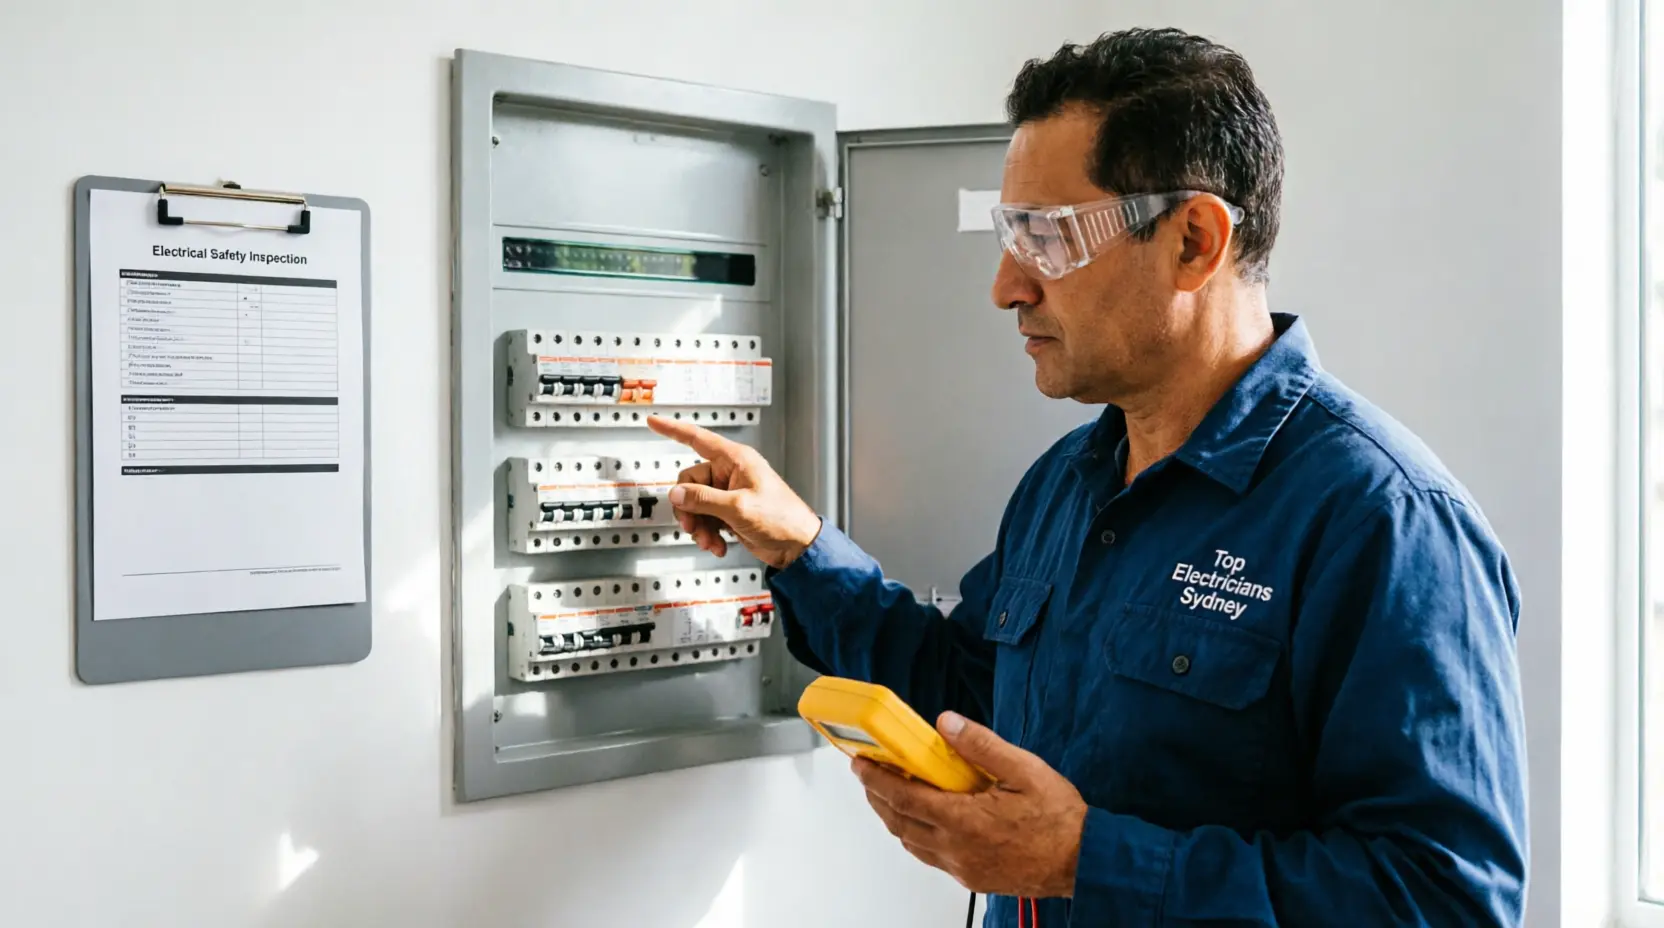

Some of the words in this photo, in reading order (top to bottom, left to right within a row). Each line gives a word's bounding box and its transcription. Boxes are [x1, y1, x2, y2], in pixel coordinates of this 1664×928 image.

[152, 245, 207, 259] Electrical
[210, 249, 247, 264] Safety
[249, 251, 308, 265] Inspection
[1214, 549, 1246, 575] Top
[1172, 562, 1274, 602] Electricians
[1180, 586, 1248, 621] Sydney
